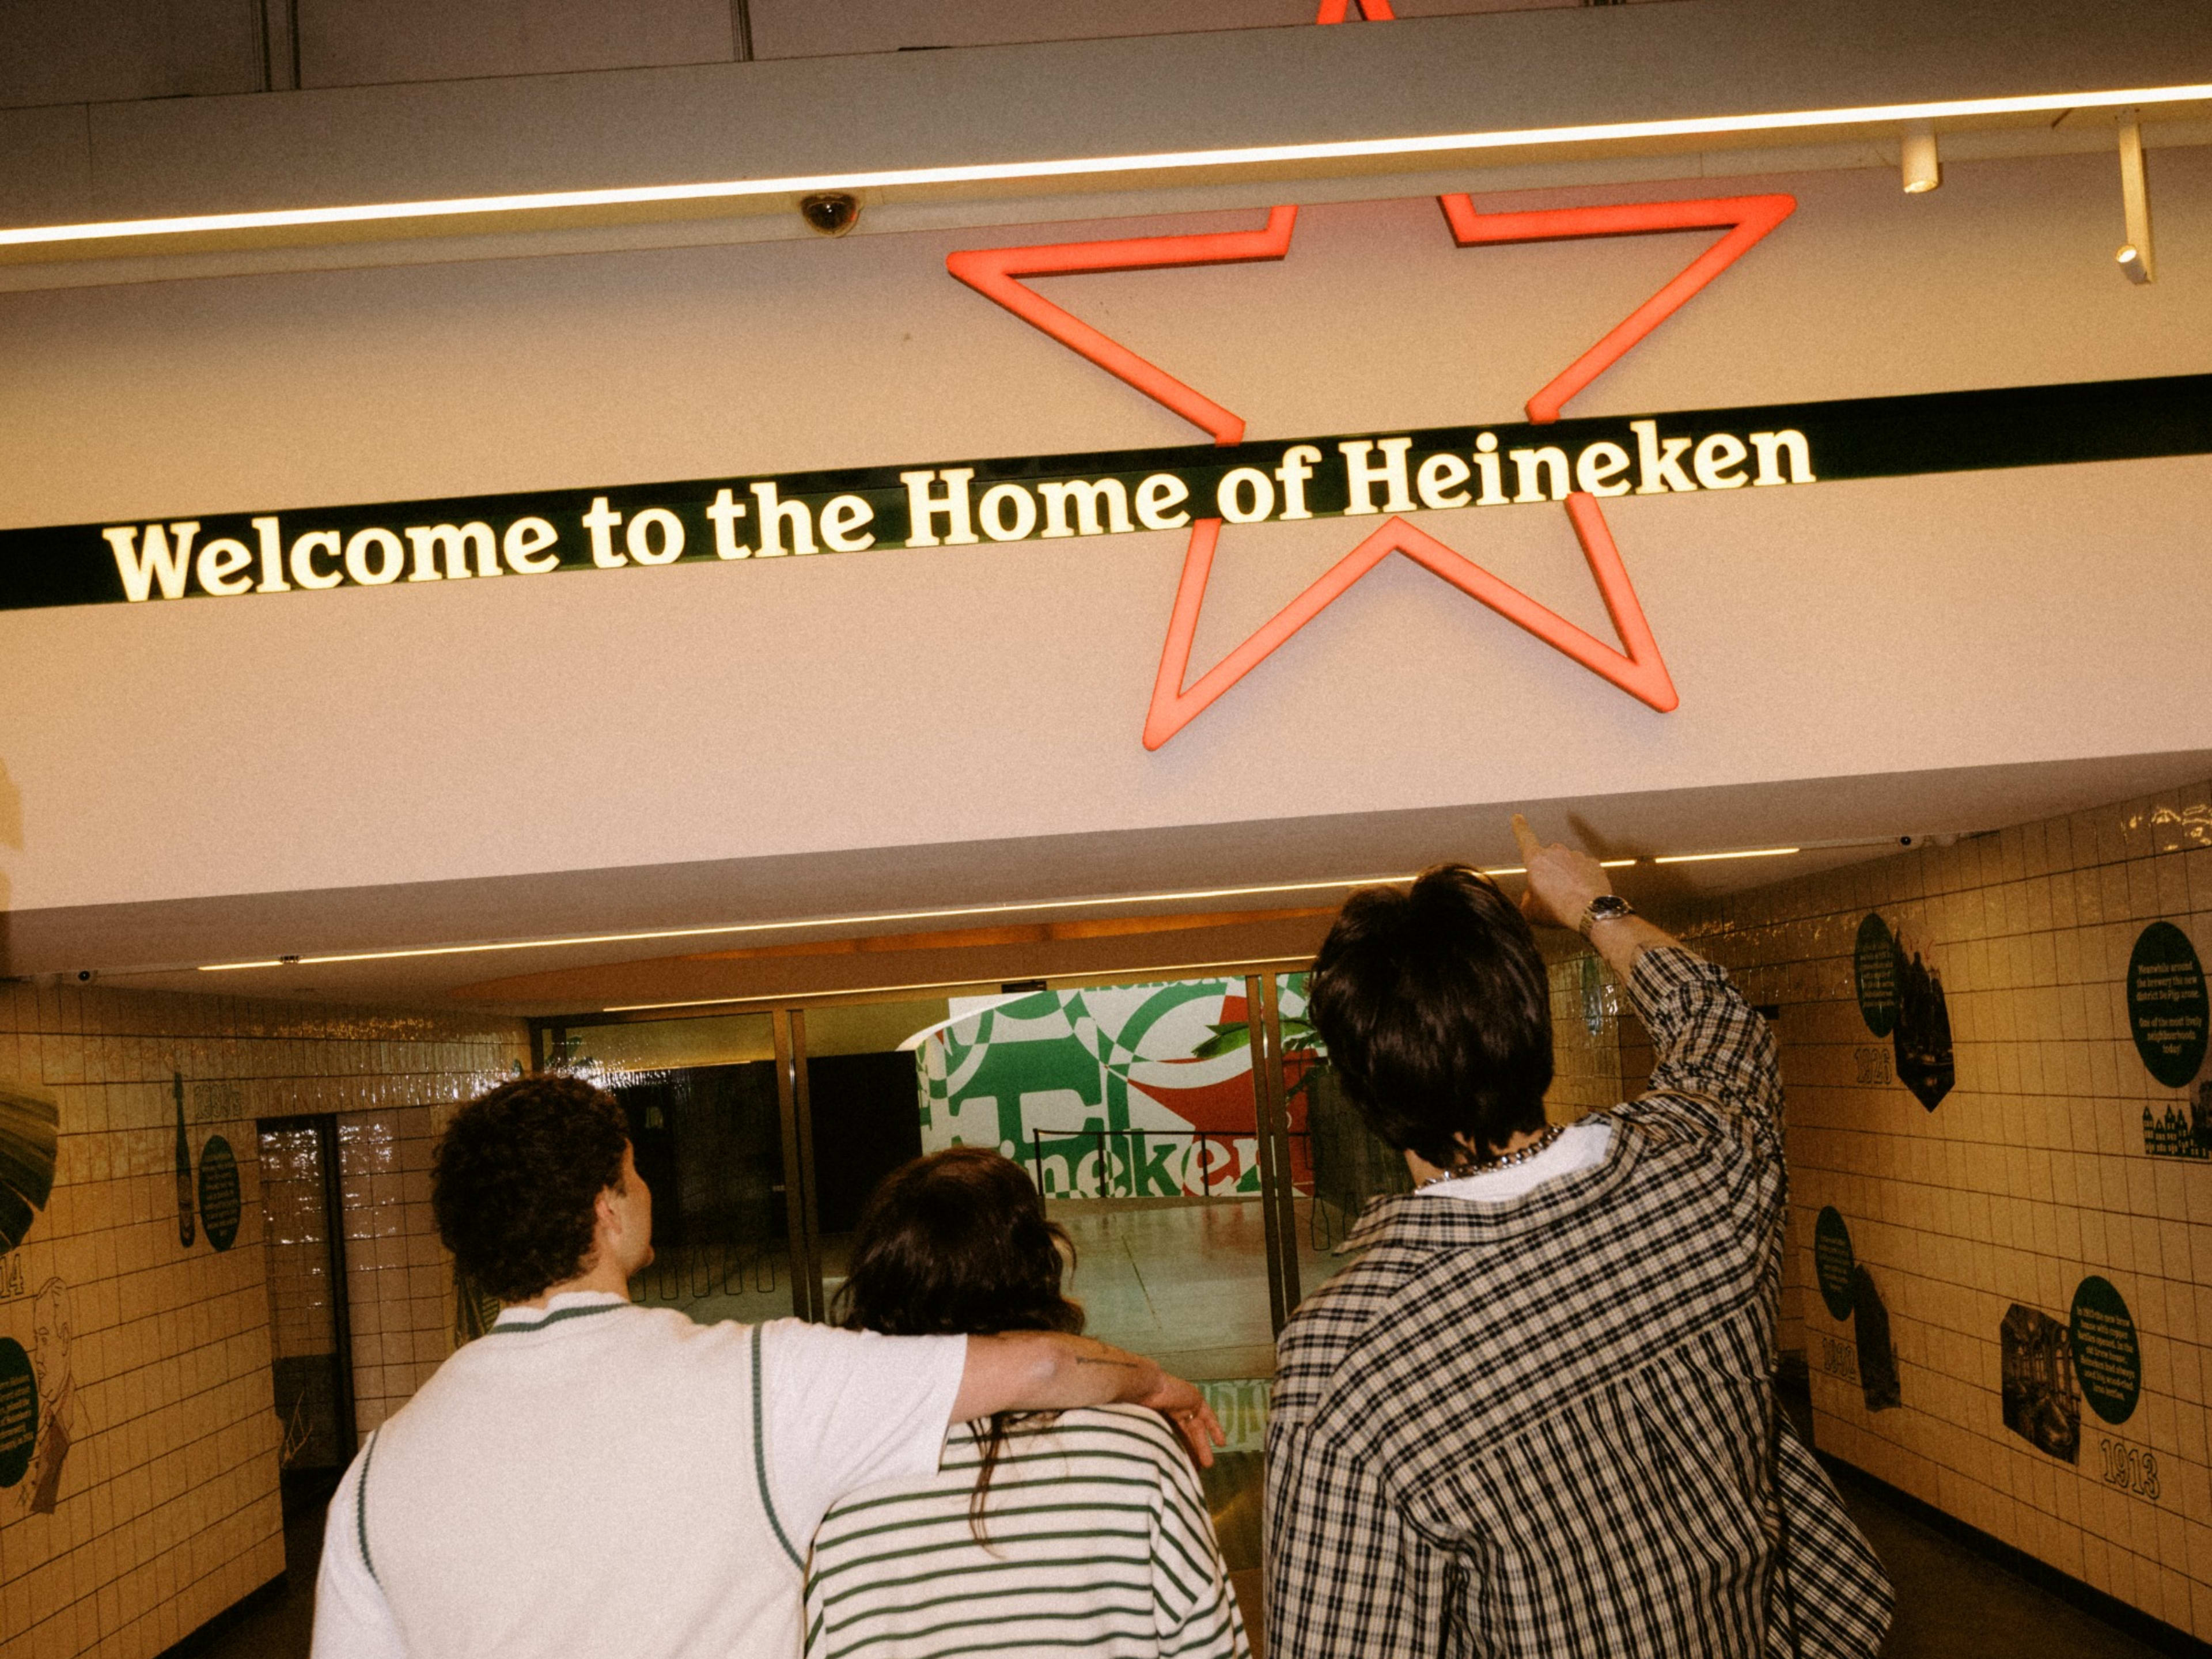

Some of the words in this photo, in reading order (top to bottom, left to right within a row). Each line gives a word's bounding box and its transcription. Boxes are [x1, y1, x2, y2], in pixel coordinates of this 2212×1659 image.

[101, 516, 560, 603] Welcome
[582, 495, 687, 570] to
[706, 480, 876, 561] the
[899, 467, 1191, 548] Home
[1217, 444, 1323, 524] of
[1338, 419, 1817, 516] Heineken
[2100, 1438, 2161, 1500] 1913
